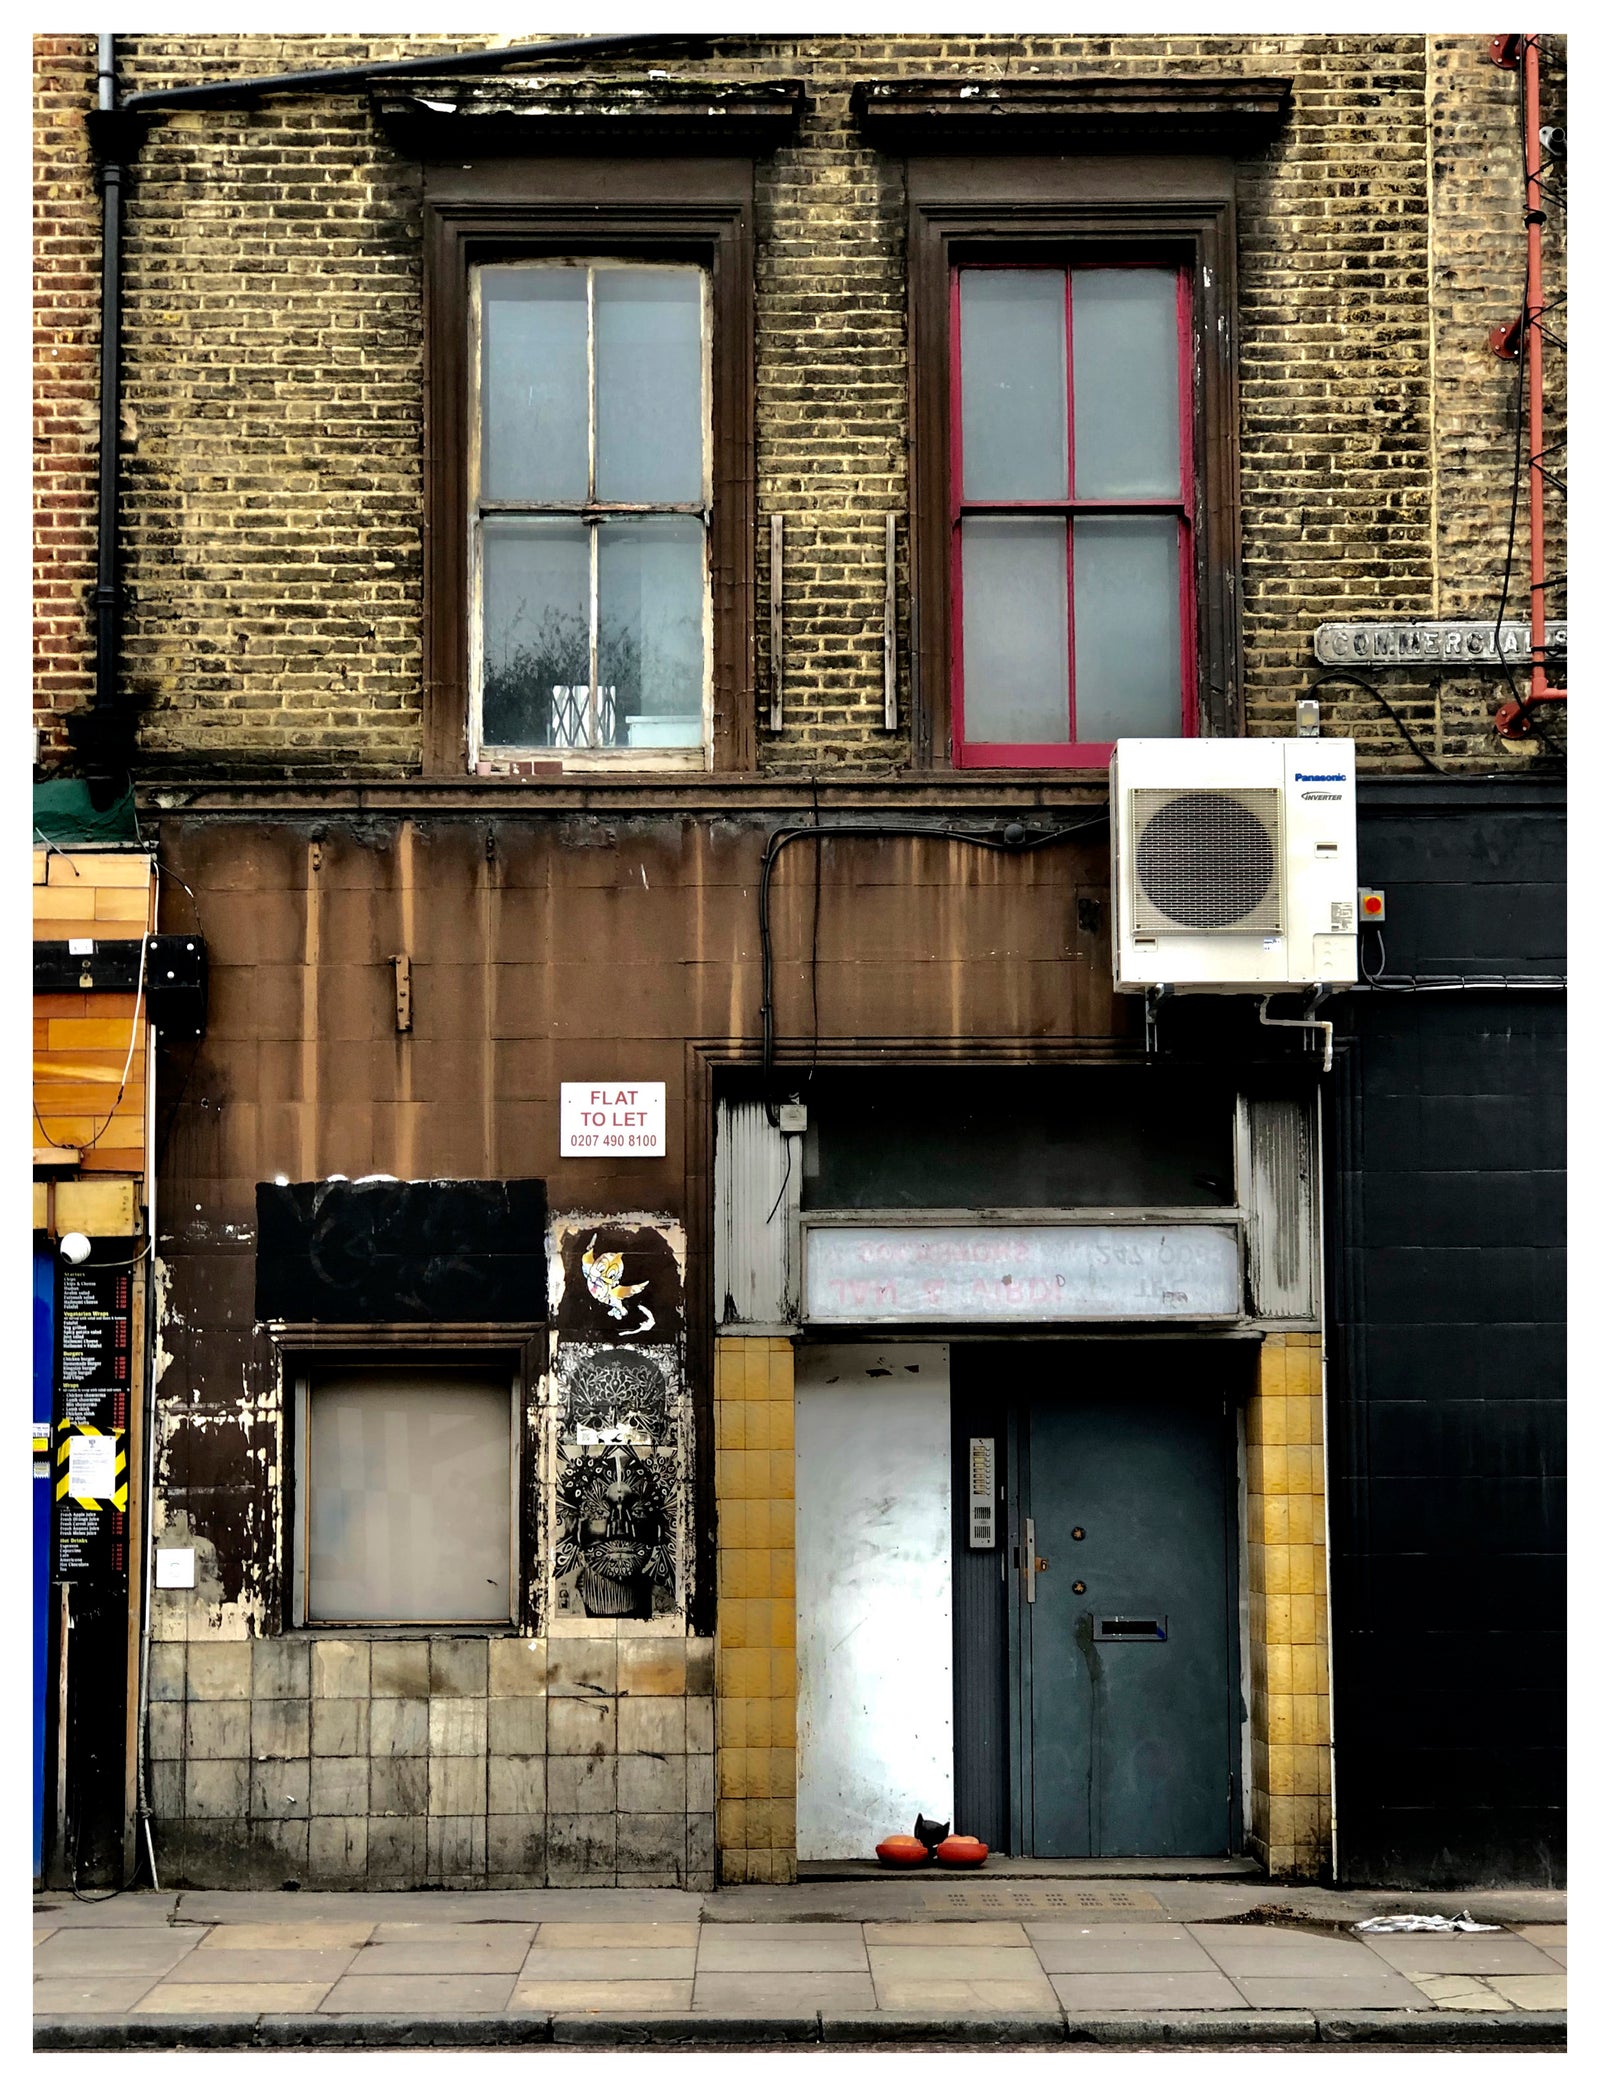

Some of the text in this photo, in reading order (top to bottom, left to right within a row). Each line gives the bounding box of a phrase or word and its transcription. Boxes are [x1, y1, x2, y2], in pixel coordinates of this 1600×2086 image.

[1332, 630, 1533, 656] COMMERCIAL
[1294, 772, 1346, 782] Panasonic
[590, 1090, 638, 1105] FLAT
[581, 1112, 648, 1127] TO LET
[570, 1134, 657, 1147] 0207 490 8100
